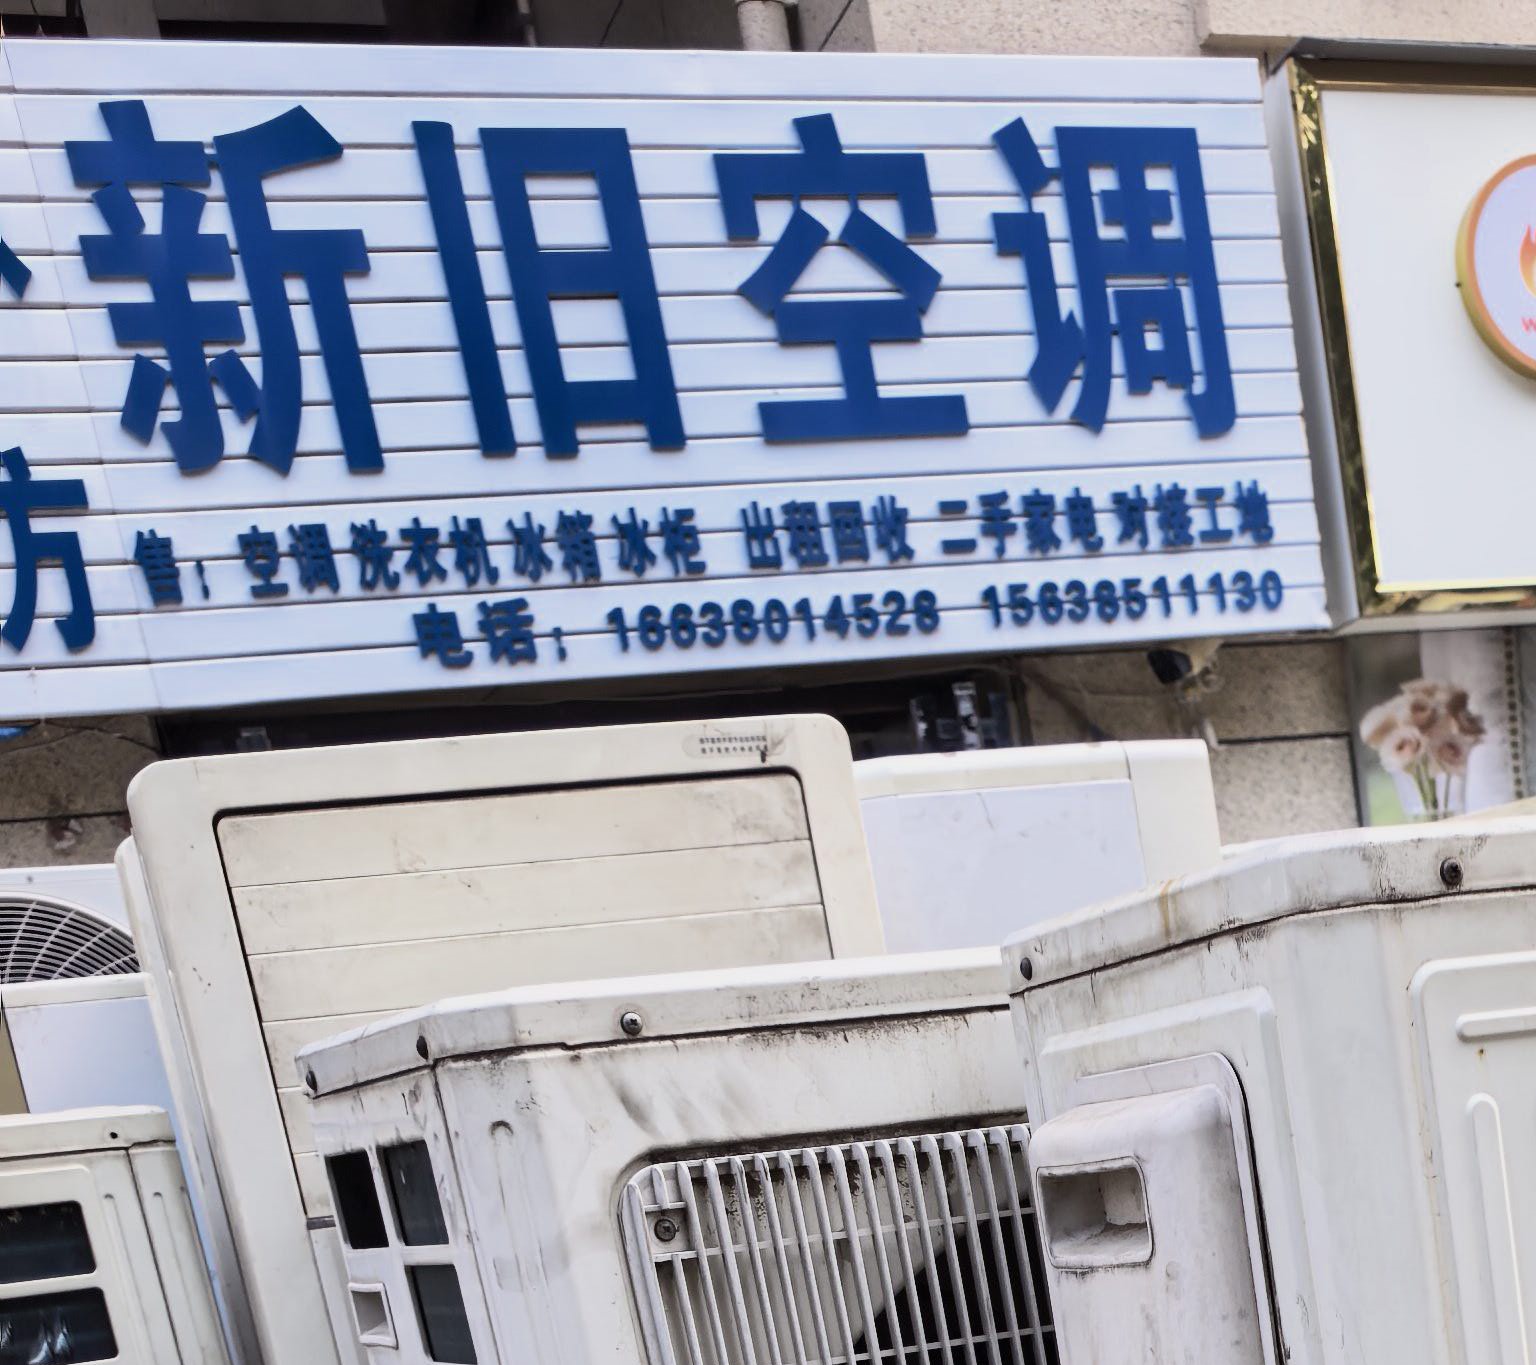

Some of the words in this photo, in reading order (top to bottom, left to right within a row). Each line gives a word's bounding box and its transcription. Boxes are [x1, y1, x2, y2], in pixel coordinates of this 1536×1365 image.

[0, 100, 1237, 475] 新旧空调
[607, 589, 940, 652] 16638014528
[980, 570, 1284, 629] 15638511130
